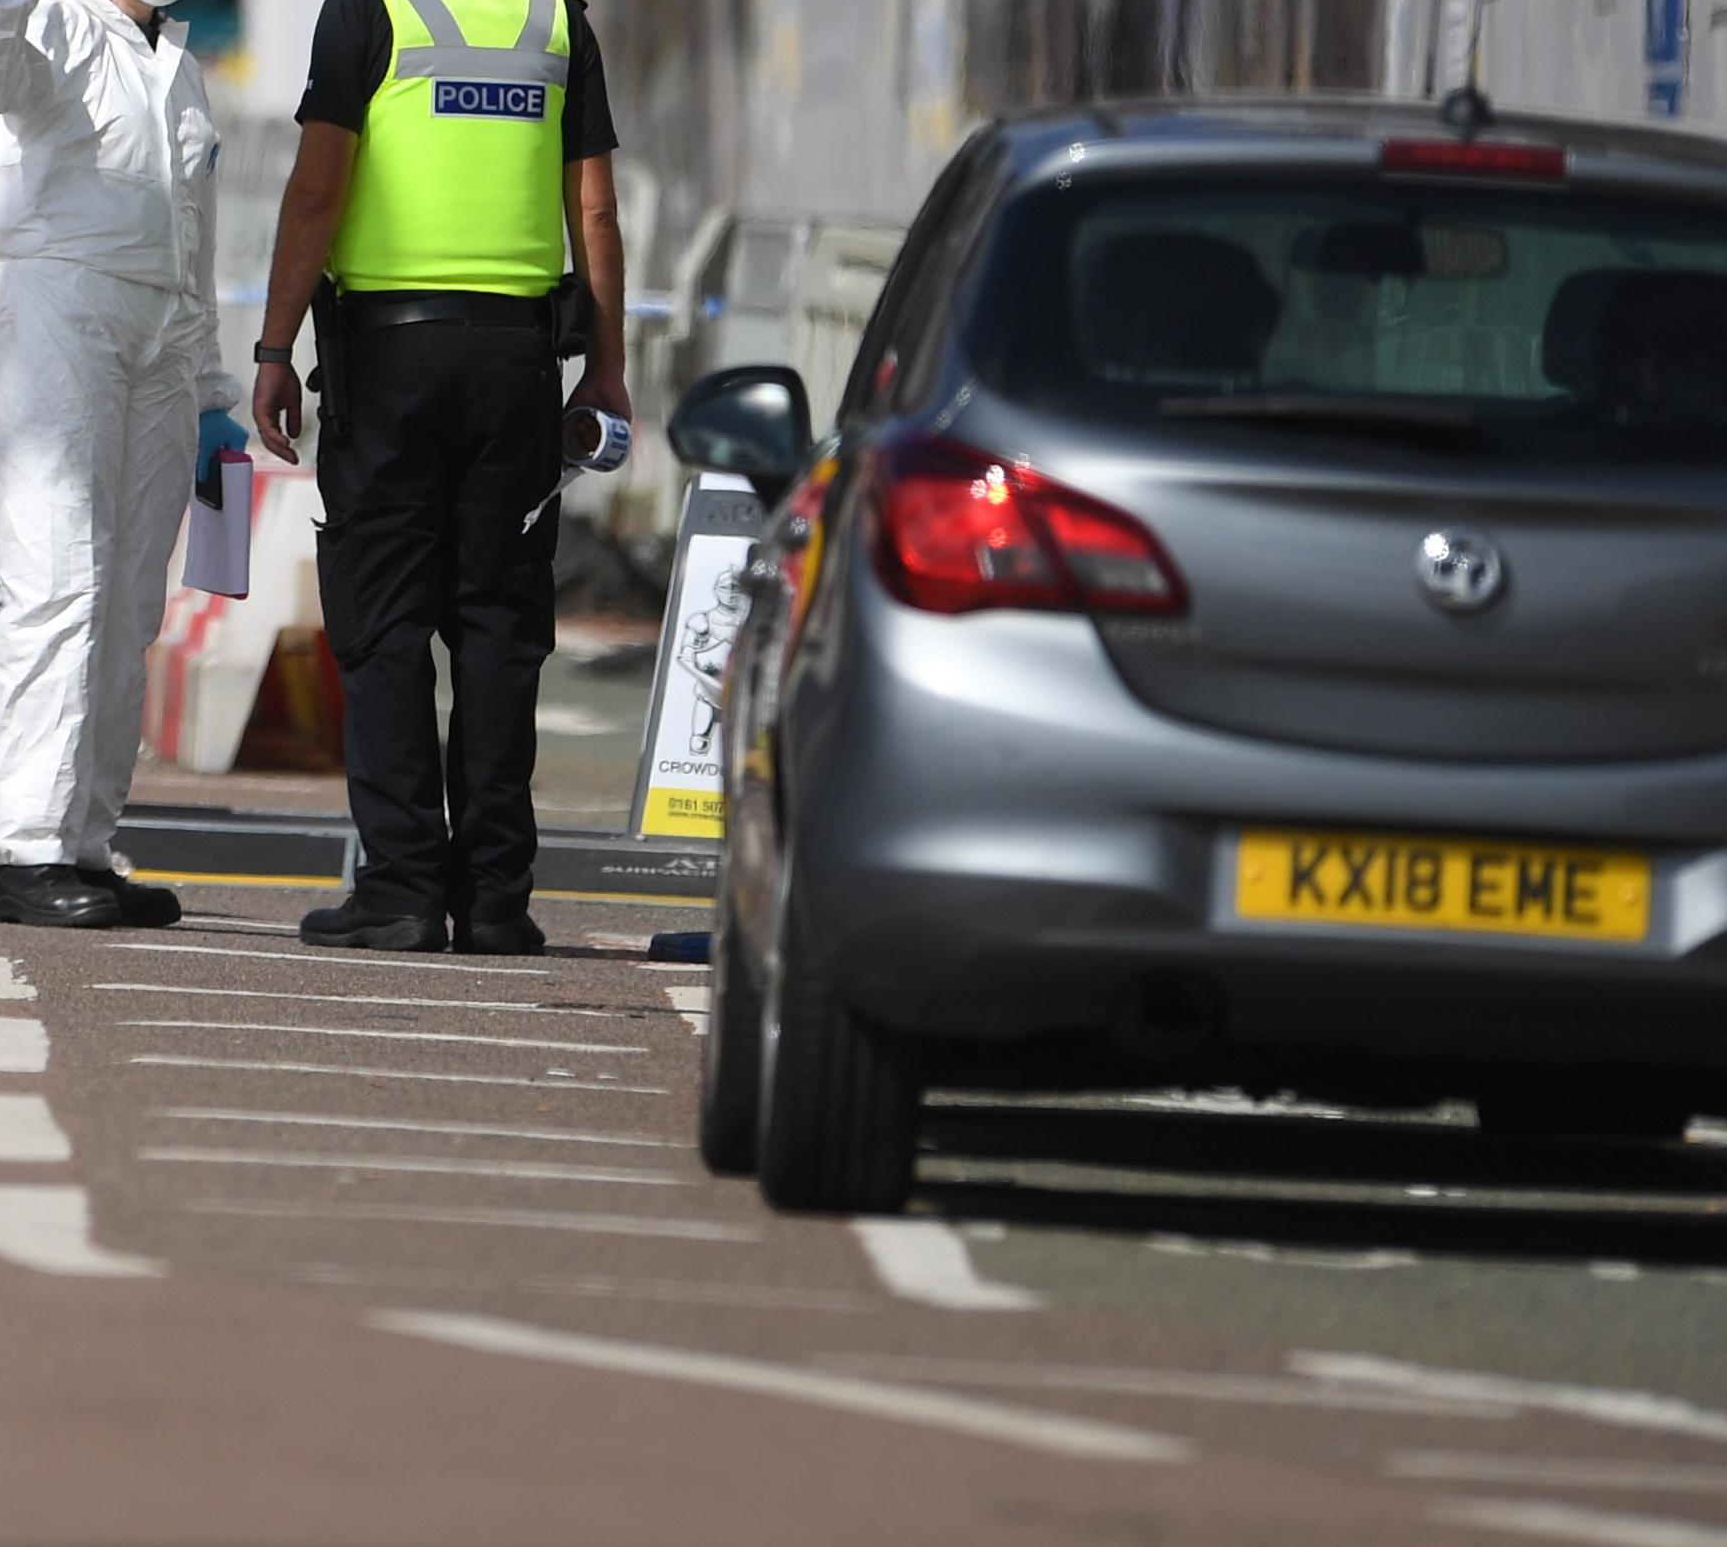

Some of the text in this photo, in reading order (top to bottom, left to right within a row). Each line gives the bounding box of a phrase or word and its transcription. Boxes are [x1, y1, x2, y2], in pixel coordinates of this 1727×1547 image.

[437, 85, 543, 113] POLICE
[1289, 841, 1604, 925] KX18 EME
